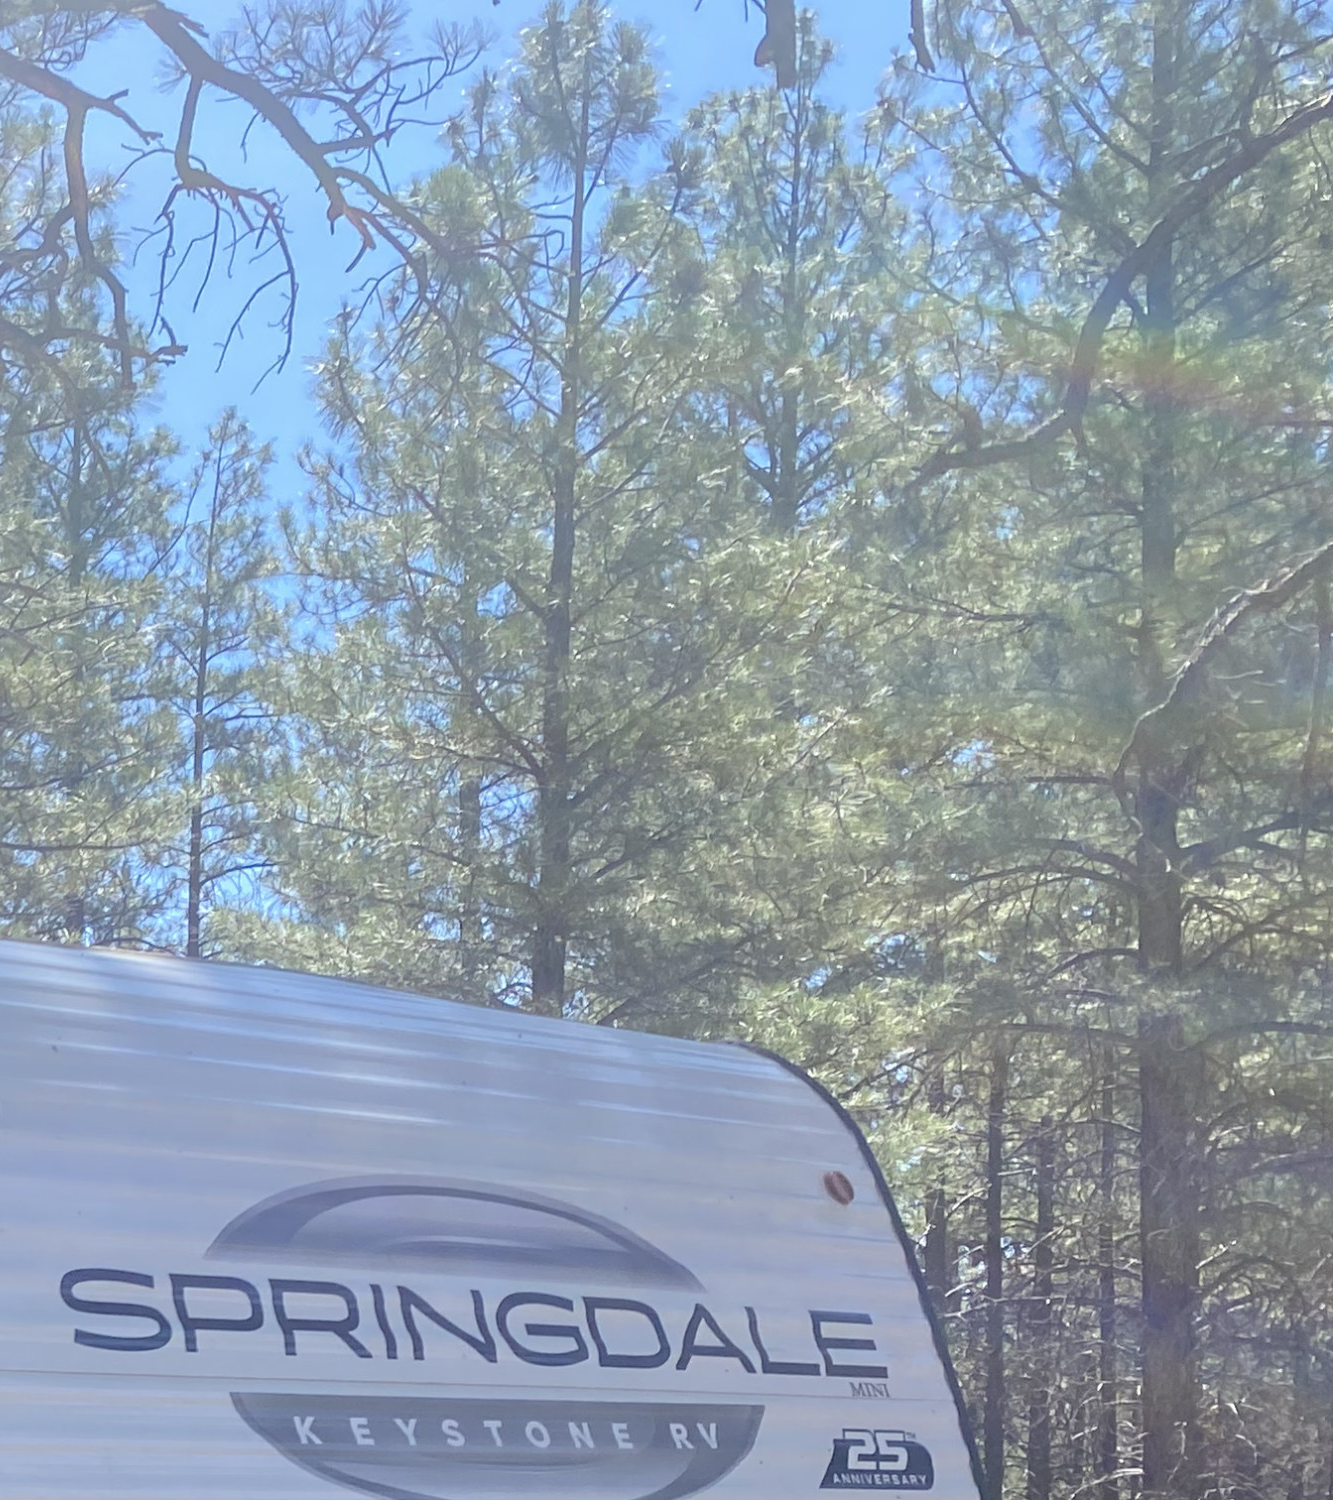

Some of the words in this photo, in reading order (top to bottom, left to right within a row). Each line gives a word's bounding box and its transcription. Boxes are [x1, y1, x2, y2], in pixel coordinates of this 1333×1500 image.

[60, 1267, 889, 1379] SPRINGDALE
[849, 1382, 890, 1398] MINI
[293, 1415, 634, 1450] KEYSTONE
[669, 1422, 719, 1450] RV
[842, 1429, 909, 1471] 25
[833, 1472, 928, 1486] ANNIVERSARY
